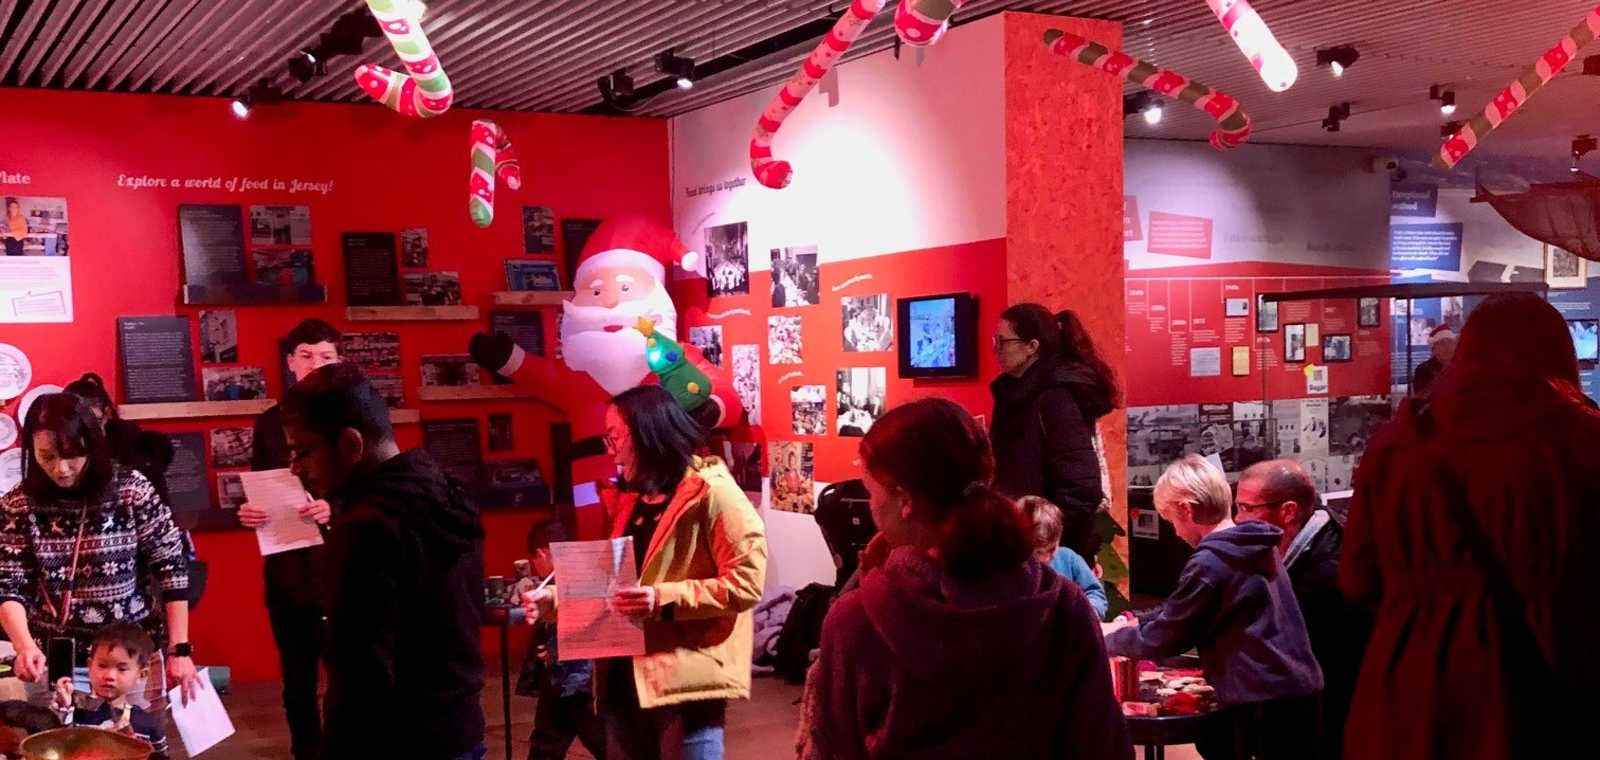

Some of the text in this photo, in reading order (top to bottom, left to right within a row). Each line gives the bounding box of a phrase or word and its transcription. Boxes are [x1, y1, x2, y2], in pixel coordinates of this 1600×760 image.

[0, 171, 31, 184] late
[118, 174, 334, 195] Explore a world of food in Jersey!
